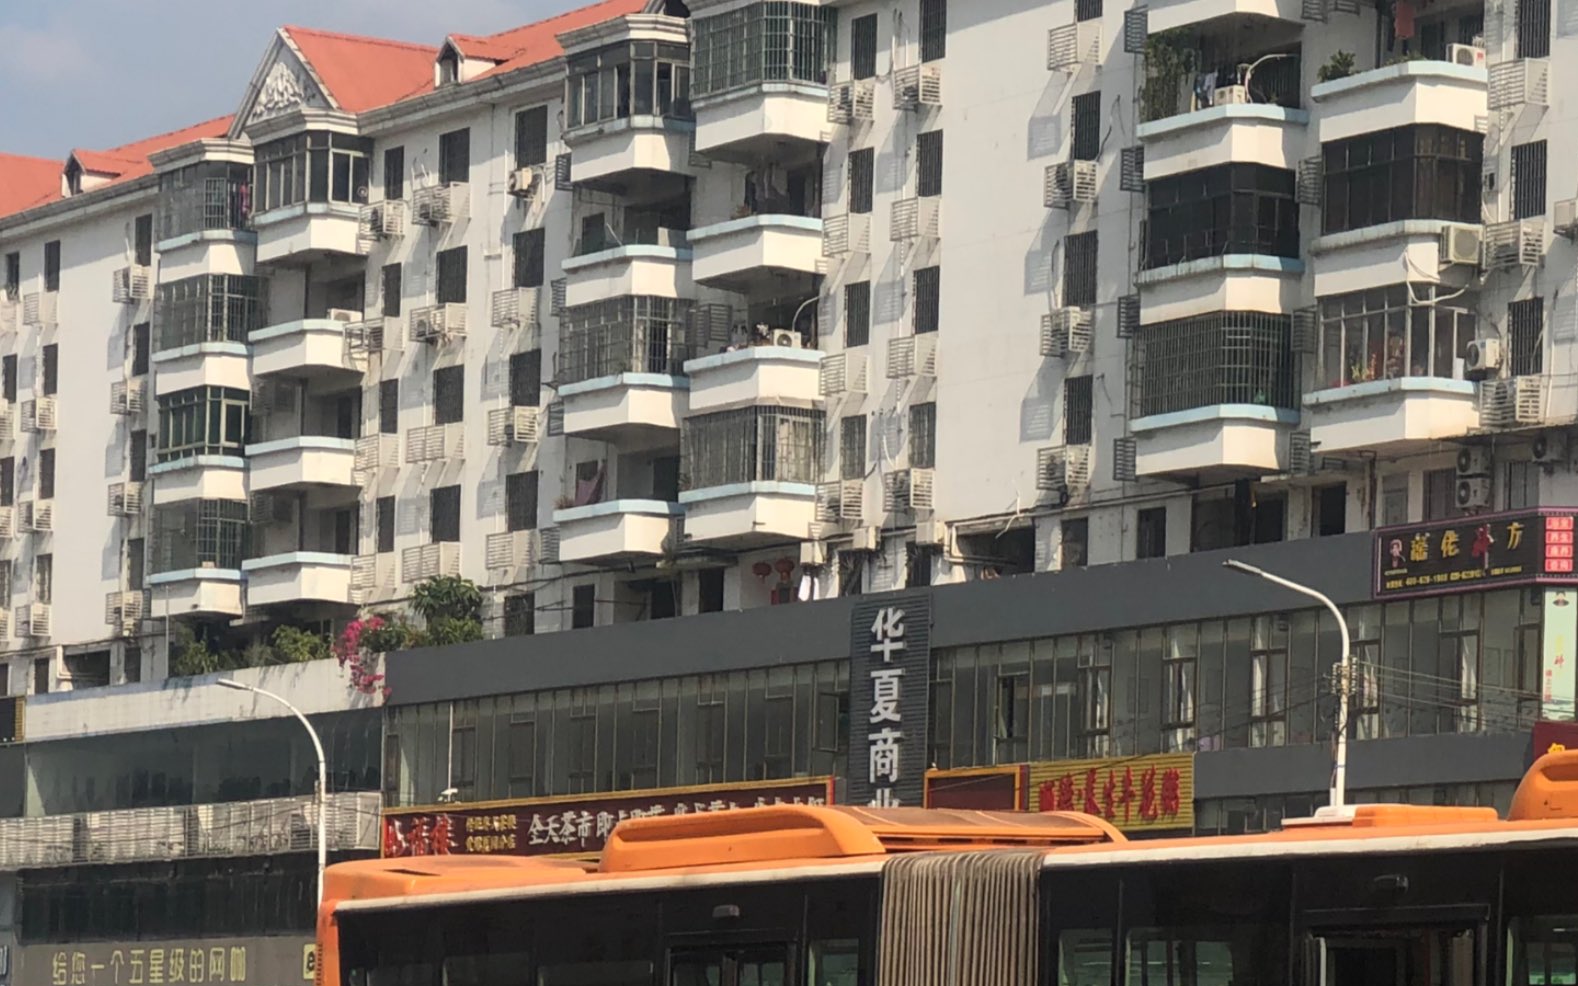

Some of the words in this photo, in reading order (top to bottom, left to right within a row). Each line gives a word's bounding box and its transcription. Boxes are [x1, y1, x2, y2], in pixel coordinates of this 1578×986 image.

[52, 946, 246, 986] 给您一个五星级的网咖
